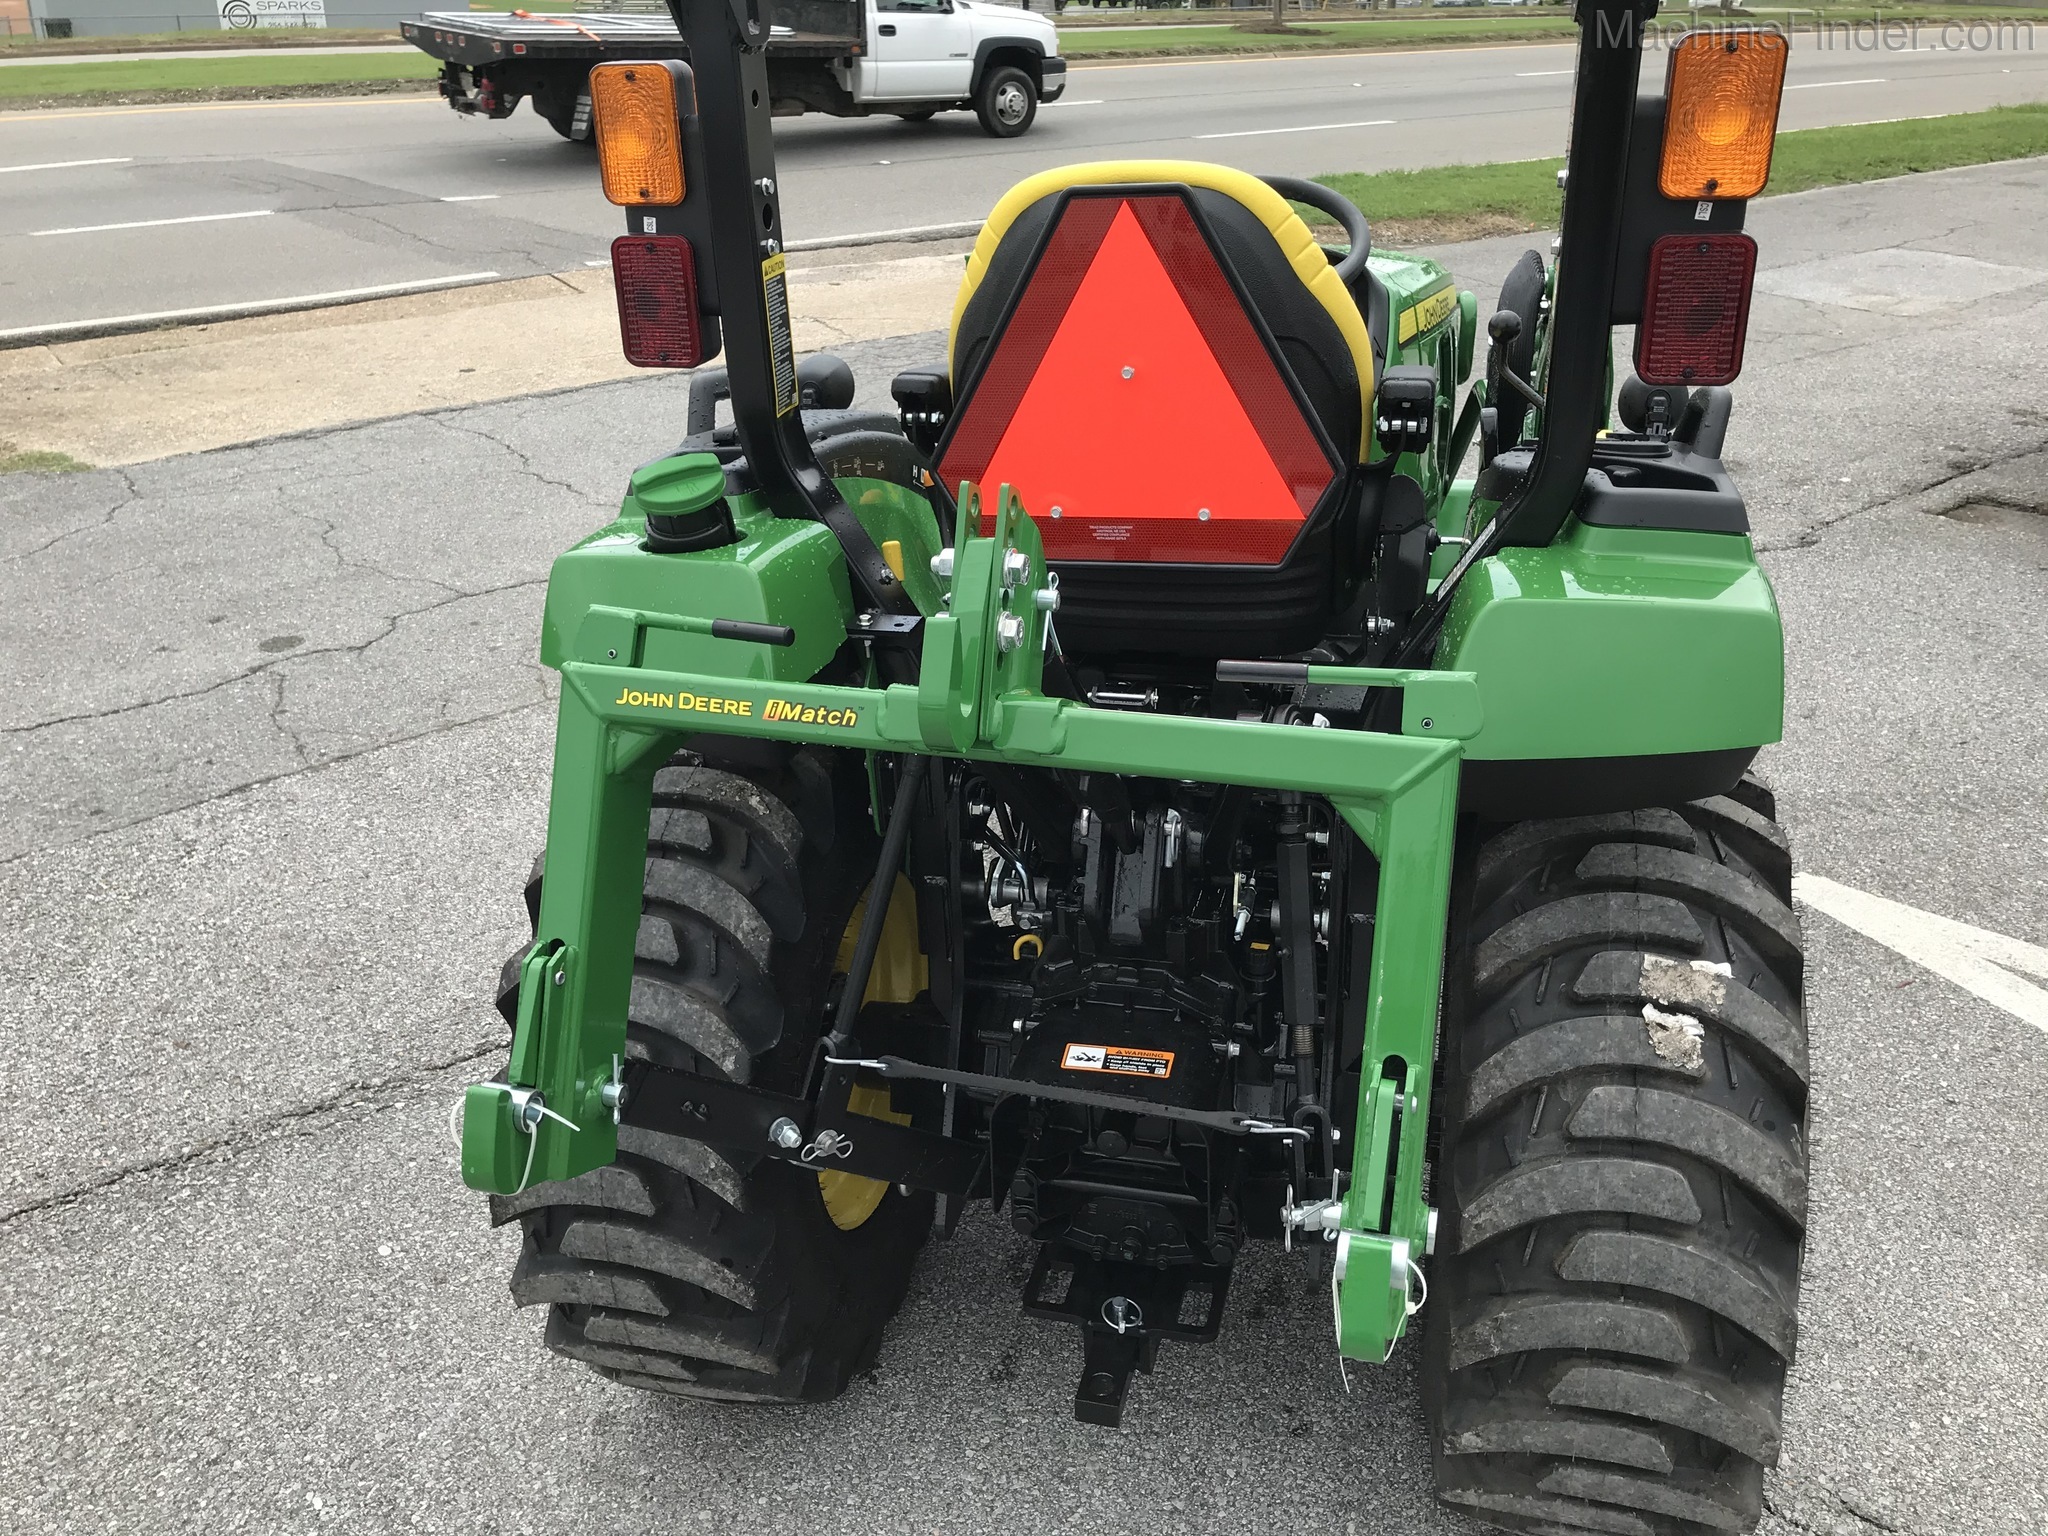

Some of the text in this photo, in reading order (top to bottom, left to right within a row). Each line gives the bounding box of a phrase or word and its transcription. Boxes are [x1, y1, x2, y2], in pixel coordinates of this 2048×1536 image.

[256, 1, 322, 11] SPARKS
[615, 688, 674, 708] JOHN
[678, 692, 752, 716] DEERE
[1124, 1050, 1164, 1058] WARNING
